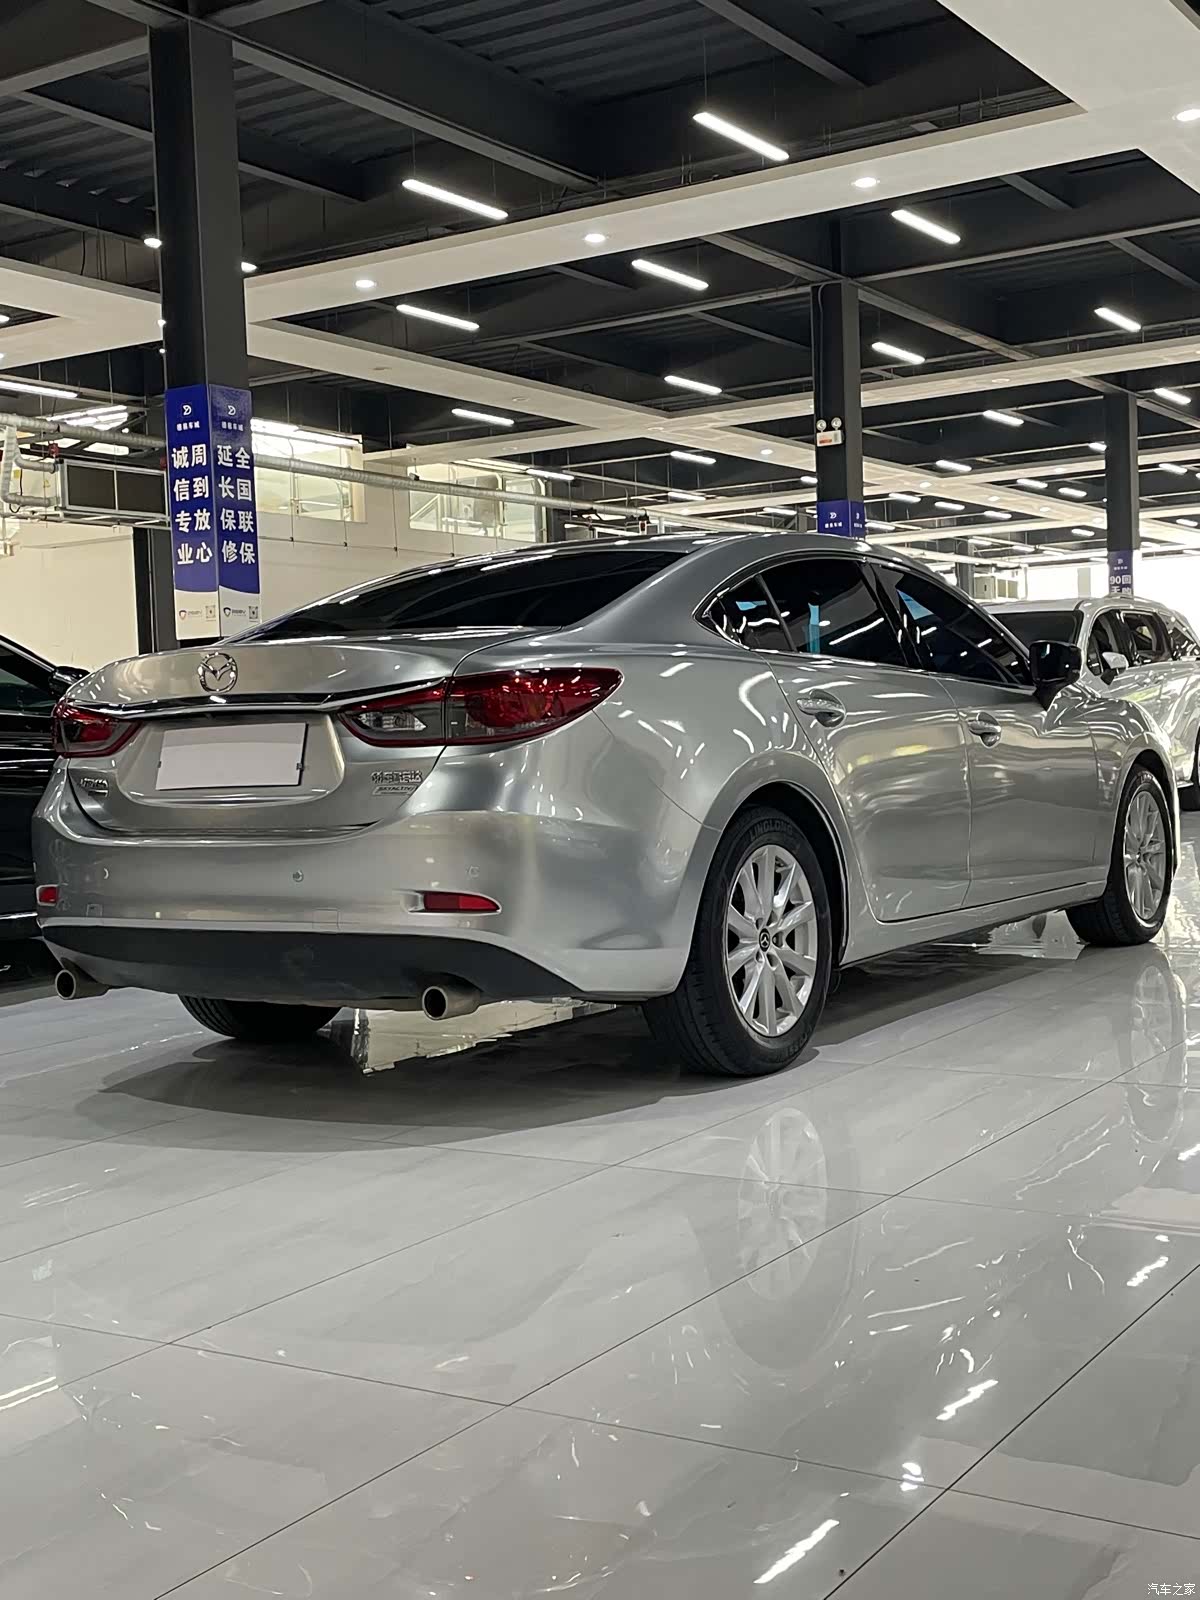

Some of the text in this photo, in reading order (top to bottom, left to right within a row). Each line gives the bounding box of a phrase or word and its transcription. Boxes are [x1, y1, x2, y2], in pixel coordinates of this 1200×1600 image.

[171, 447, 193, 565] 诚信专业
[191, 444, 213, 564] 周到放心
[217, 445, 238, 563] 延长保修
[235, 447, 256, 564] 全国联保
